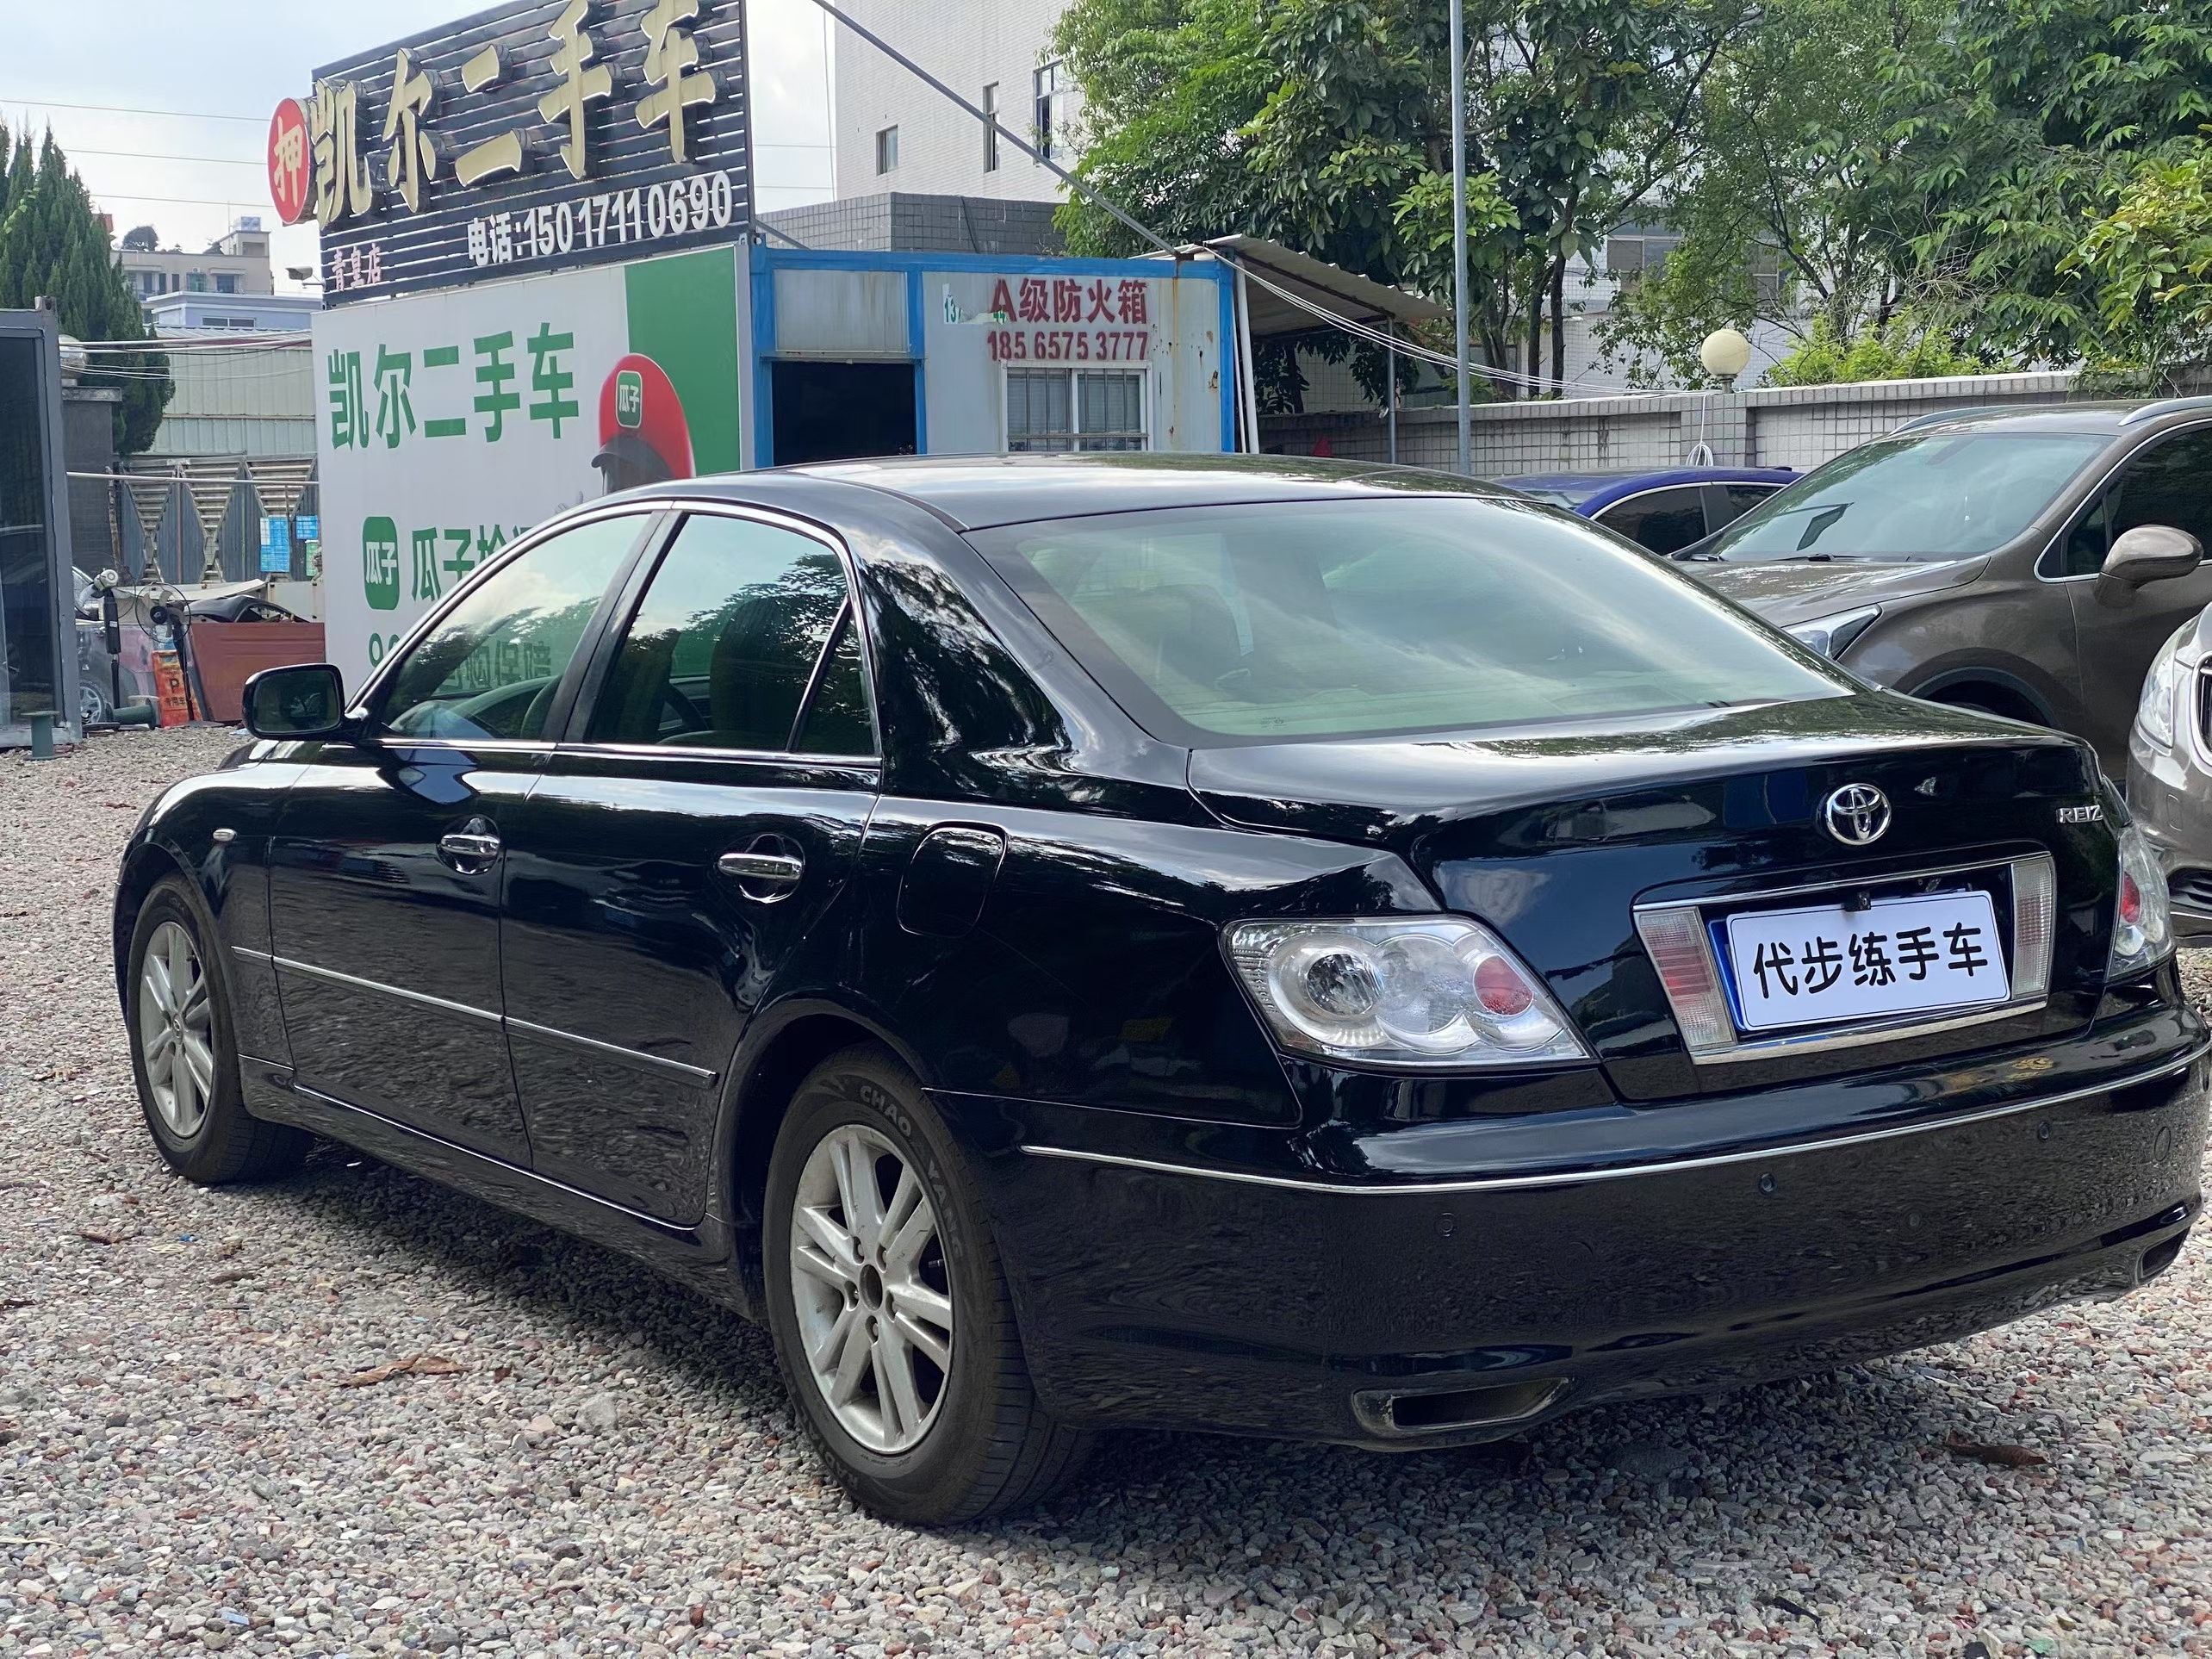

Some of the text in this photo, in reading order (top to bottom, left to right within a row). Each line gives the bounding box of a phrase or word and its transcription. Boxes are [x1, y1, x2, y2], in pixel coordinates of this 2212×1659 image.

[310, 0, 715, 230] 凯尔二手车
[273, 115, 305, 208] 押
[990, 277, 1146, 324] A级防火箱
[987, 331, 1147, 360] 185 6575 3777
[327, 322, 579, 450] 凯尔二手车
[618, 384, 640, 413] 瓜子
[366, 541, 397, 585] 瓜子
[2056, 805, 2103, 823] REIZ
[1754, 923, 1988, 999] 代步练手车
[860, 1085, 911, 1137] CHAO
